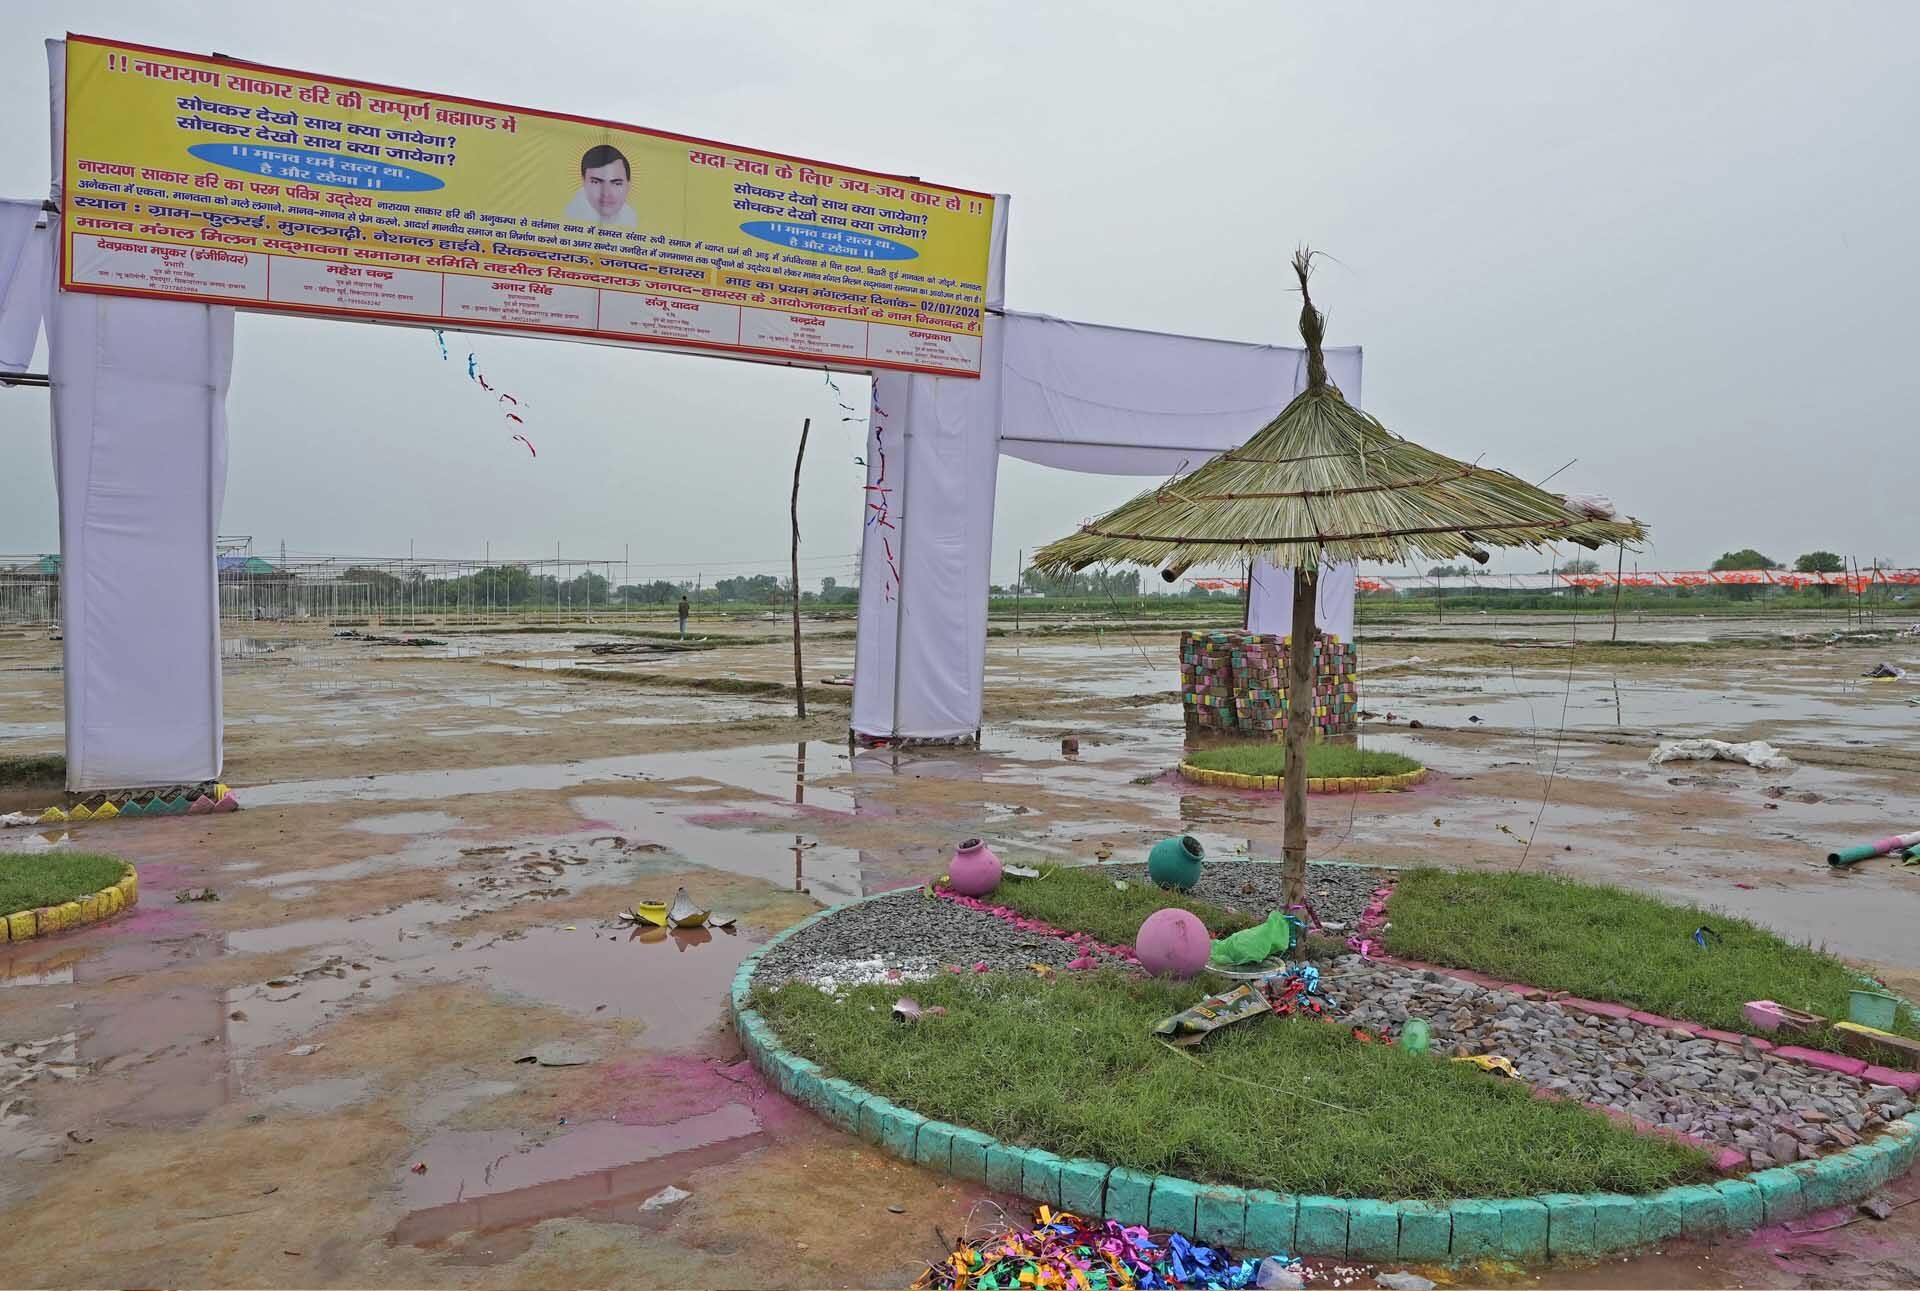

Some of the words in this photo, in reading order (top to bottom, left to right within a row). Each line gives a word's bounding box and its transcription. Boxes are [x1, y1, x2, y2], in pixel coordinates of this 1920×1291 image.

[134, 59, 219, 87] नारायण
[226, 75, 293, 98] साकार
[298, 85, 330, 104] हरि
[335, 90, 361, 109] की
[368, 98, 430, 121] सम्पूर्ण
[501, 114, 516, 133] में
[176, 95, 252, 118] सोचकर
[255, 106, 298, 125] देखो
[303, 116, 342, 132] साथ
[346, 123, 381, 138] क्या
[385, 129, 456, 148] जायेगा?
[176, 114, 252, 137] सोचकर
[255, 124, 298, 144] देखो
[303, 135, 342, 150] साथ
[346, 141, 380, 156] क्या
[384, 147, 455, 166] जायेगा?
[78, 159, 135, 177] नारायण
[141, 167, 190, 184] साकार
[194, 172, 219, 188] हरि
[223, 178, 244, 191] का
[249, 182, 280, 196] परम
[285, 184, 320, 201] पवित्र
[253, 149, 299, 163] मानव
[306, 157, 334, 168] धर्म
[340, 161, 377, 174] सत्य
[260, 162, 271, 173] है
[280, 166, 309, 178] और
[316, 170, 357, 185] रहेगा
[689, 150, 768, 175] सदा-सदा
[775, 163, 792, 178] के
[799, 167, 833, 187] लिए
[839, 177, 905, 200] जय-जय
[910, 190, 940, 206] कार
[945, 195, 960, 210] हो
[732, 197, 784, 216] सोचकर
[787, 205, 817, 221] देखो
[820, 214, 847, 226] साथ
[850, 218, 874, 230] क्या
[877, 223, 927, 239] जायेगा?
[733, 182, 785, 200] सोचकर
[788, 190, 818, 206] देखो
[821, 198, 848, 211] साथ
[851, 204, 875, 216] क्या
[878, 208, 928, 225] जायेगा?
[74, 196, 127, 211] स्थान
[373, 229, 435, 247] नेशनल
[599, 257, 704, 278] जनपद-हाथरस
[96, 237, 147, 253] देवप्रकाश
[150, 246, 186, 259] मधुकर
[190, 247, 248, 266] (इंजीनियर)
[76, 216, 133, 232] मानव
[139, 222, 195, 239] मंगल
[200, 227, 257, 246] मिलन
[353, 248, 420, 264] समागम
[425, 254, 479, 269] समिति
[483, 262, 544, 276] तहसील
[546, 265, 641, 287] सिकन्दराराऊ
[644, 280, 747, 300] जनपद-हाथरस
[751, 292, 766, 302] के
[870, 307, 884, 317] के
[887, 311, 912, 321] नाम
[326, 264, 362, 276] महेश
[365, 269, 393, 280] चन्द्र
[491, 282, 525, 292] अनार
[528, 282, 553, 295] सिंह
[644, 296, 669, 311] संजू
[670, 301, 699, 311] यादव
[725, 276, 752, 288] माह
[755, 280, 774, 290] का
[778, 283, 808, 295] प्रथम
[812, 287, 868, 302] मंगलवार
[920, 300, 979, 318] 02/07/2024
[790, 315, 825, 326] चन्द्रदेव
[908, 330, 951, 342] रामप्रकाश
